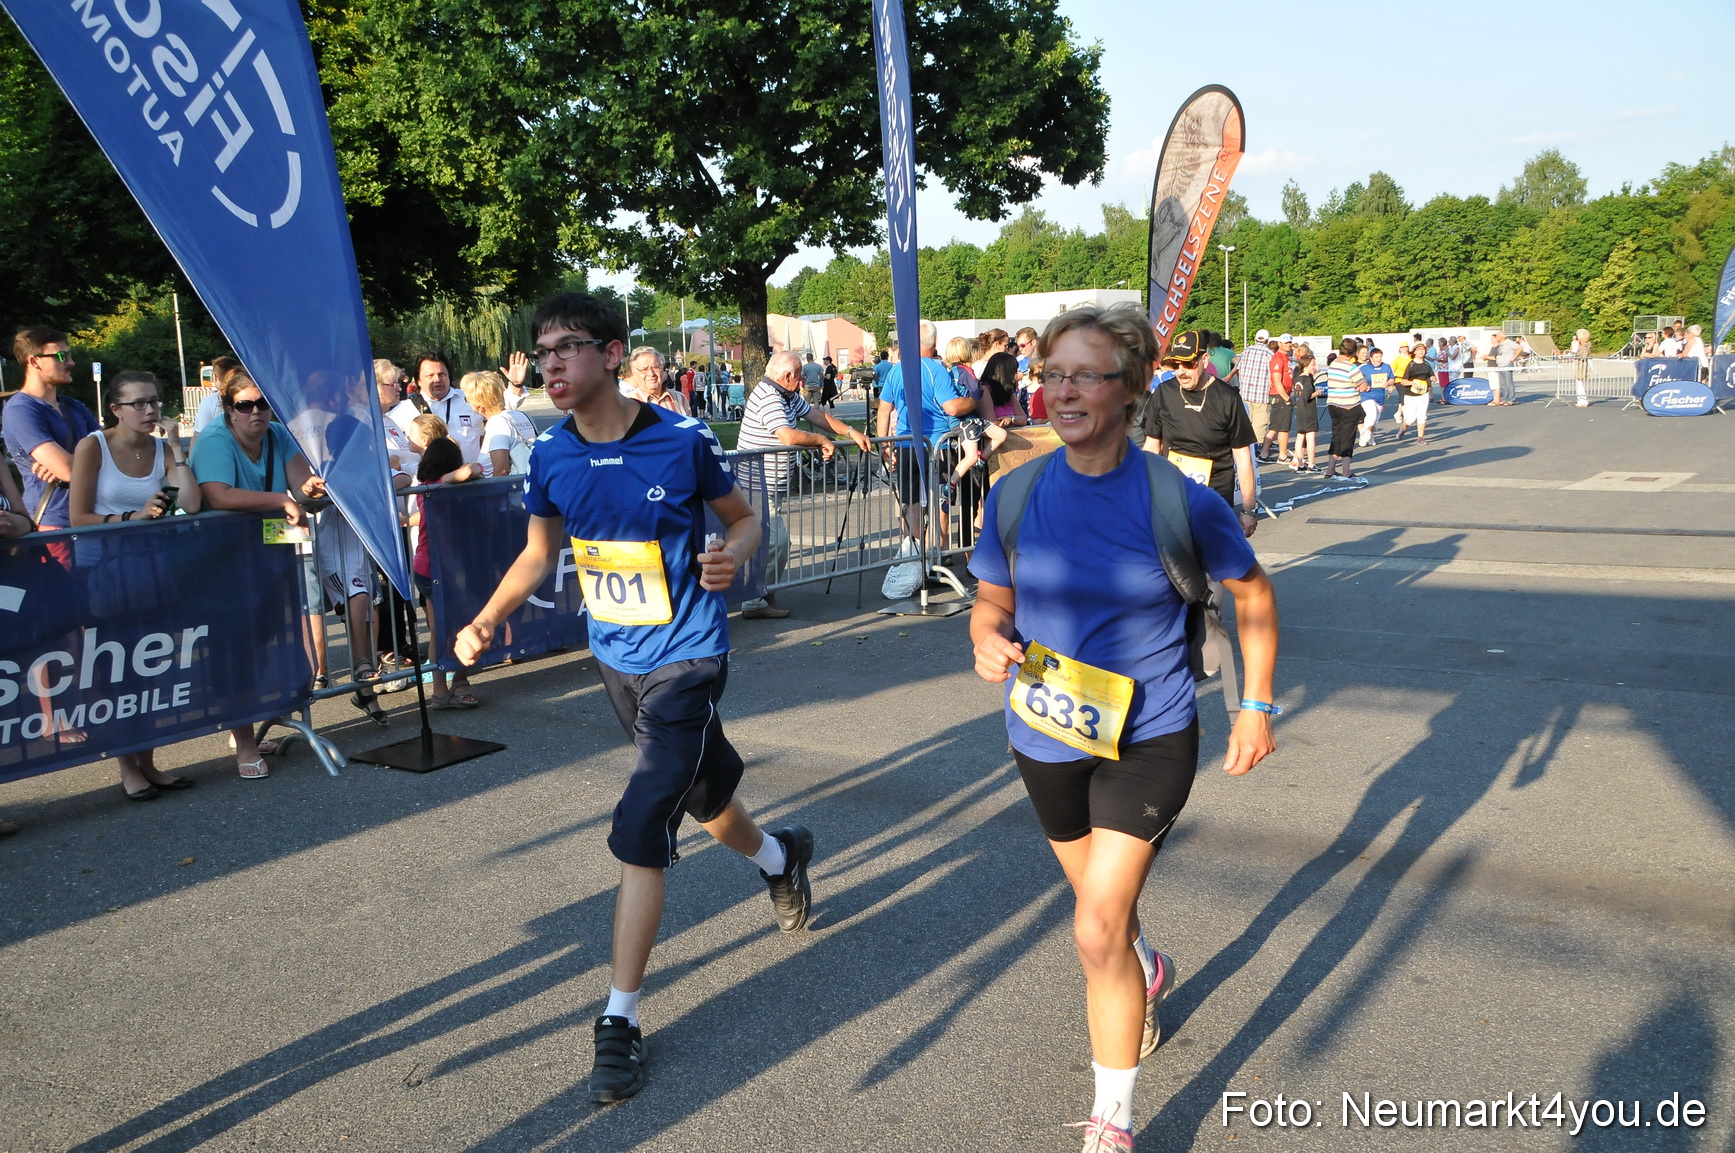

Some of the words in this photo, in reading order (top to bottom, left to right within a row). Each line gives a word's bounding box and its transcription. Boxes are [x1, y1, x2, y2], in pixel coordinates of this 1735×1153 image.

[1661, 394, 1707, 405] Fischer
[590, 456, 623, 467] hummel
[586, 569, 646, 605] 701
[1026, 683, 1101, 740] 633
